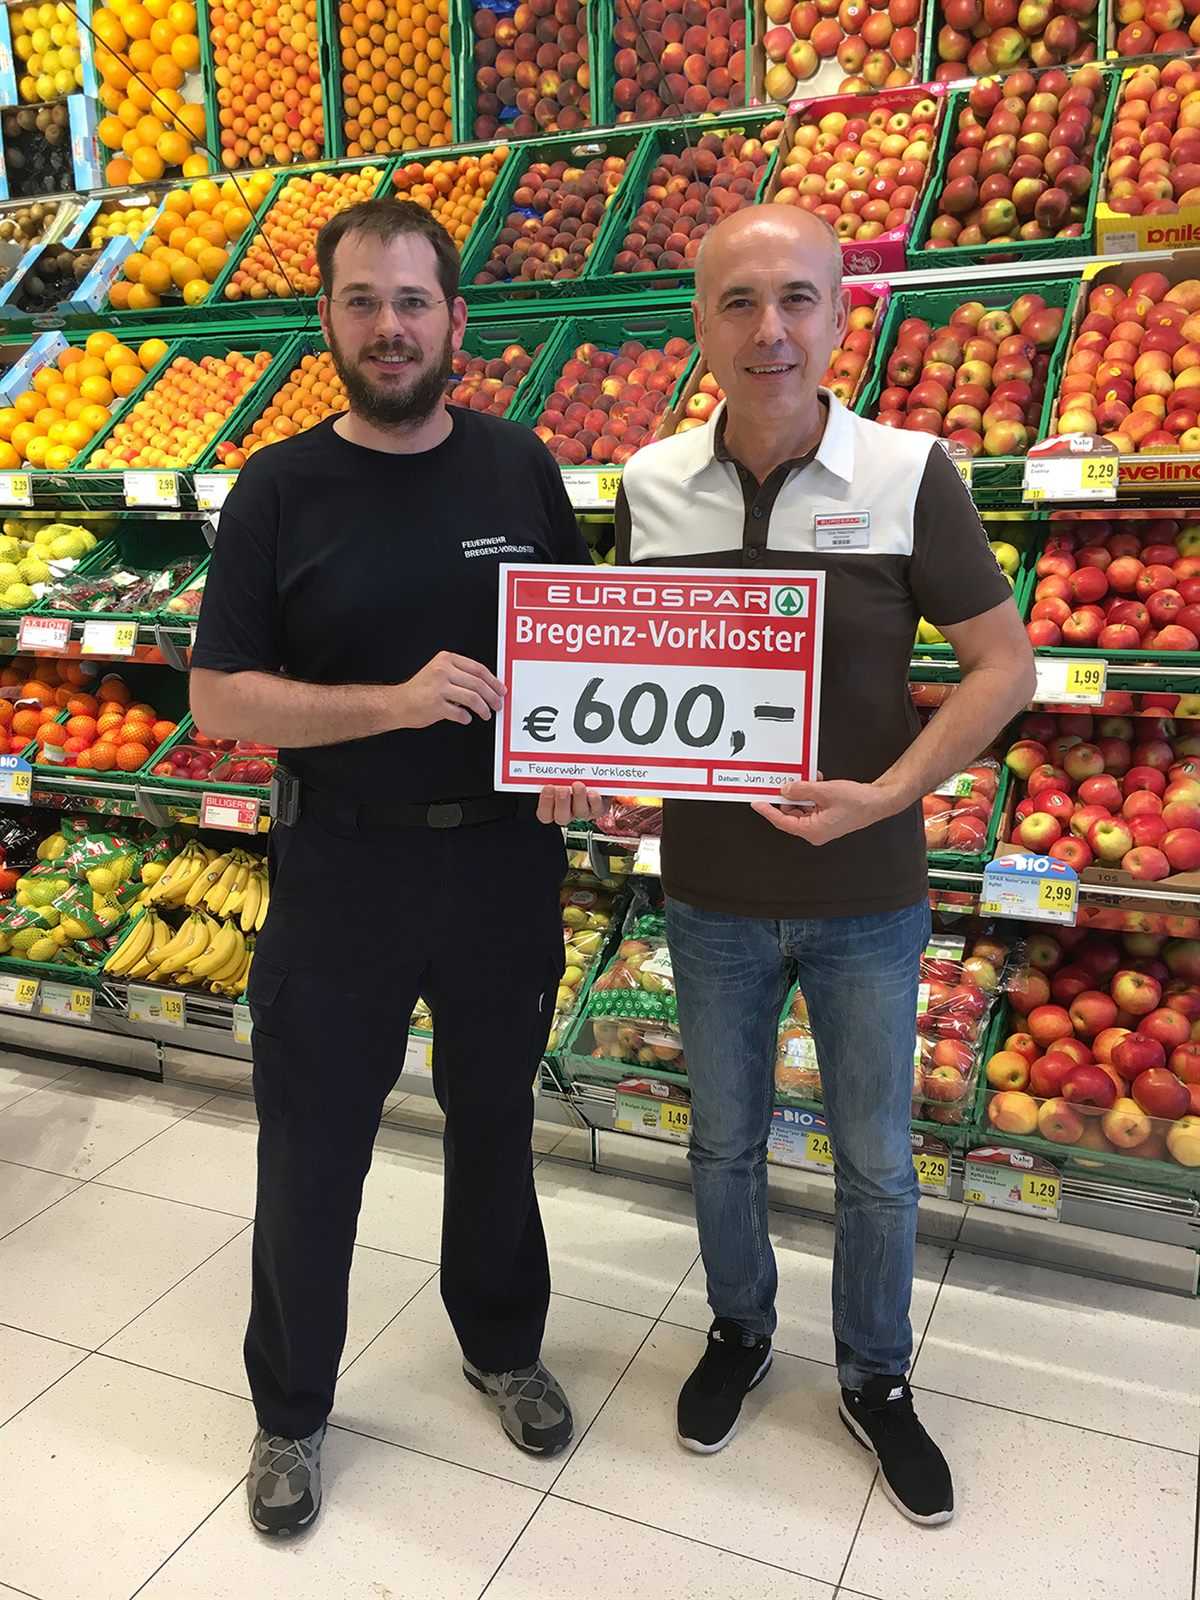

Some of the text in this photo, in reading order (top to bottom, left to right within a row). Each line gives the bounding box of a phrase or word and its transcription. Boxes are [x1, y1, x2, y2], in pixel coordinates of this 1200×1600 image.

[1087, 464, 1114, 480] 2,29
[159, 479, 174, 490] 2,99
[461, 535, 507, 549] FEUERWEHR
[464, 545, 535, 559] BREGENZ-VORKLOSTER
[547, 585, 768, 610] EUROSPAR
[117, 629, 133, 641] 2,49
[515, 615, 807, 653] Bregenz-Vorkloster
[1074, 670, 1100, 686] 1,99
[522, 706, 559, 743] €
[528, 763, 649, 778] Feuerwehr Vorkloster
[15, 775, 30, 787] 1,99
[717, 774, 740, 782] Datum:
[744, 774, 765, 784] Juni
[206, 797, 247, 809] BILLIGER!
[1098, 873, 1119, 883] 105
[1044, 885, 1072, 901] 2,99
[990, 903, 998, 911] 33
[20, 984, 36, 997] 1,99
[75, 994, 91, 1007] 0,79
[165, 1001, 181, 1013] 1,39
[668, 1111, 688, 1126] 1,49
[783, 1109, 814, 1126] BIO
[919, 1160, 945, 1177] 2,29
[972, 1192, 981, 1200] 42
[1029, 1181, 1056, 1198] 1,29
